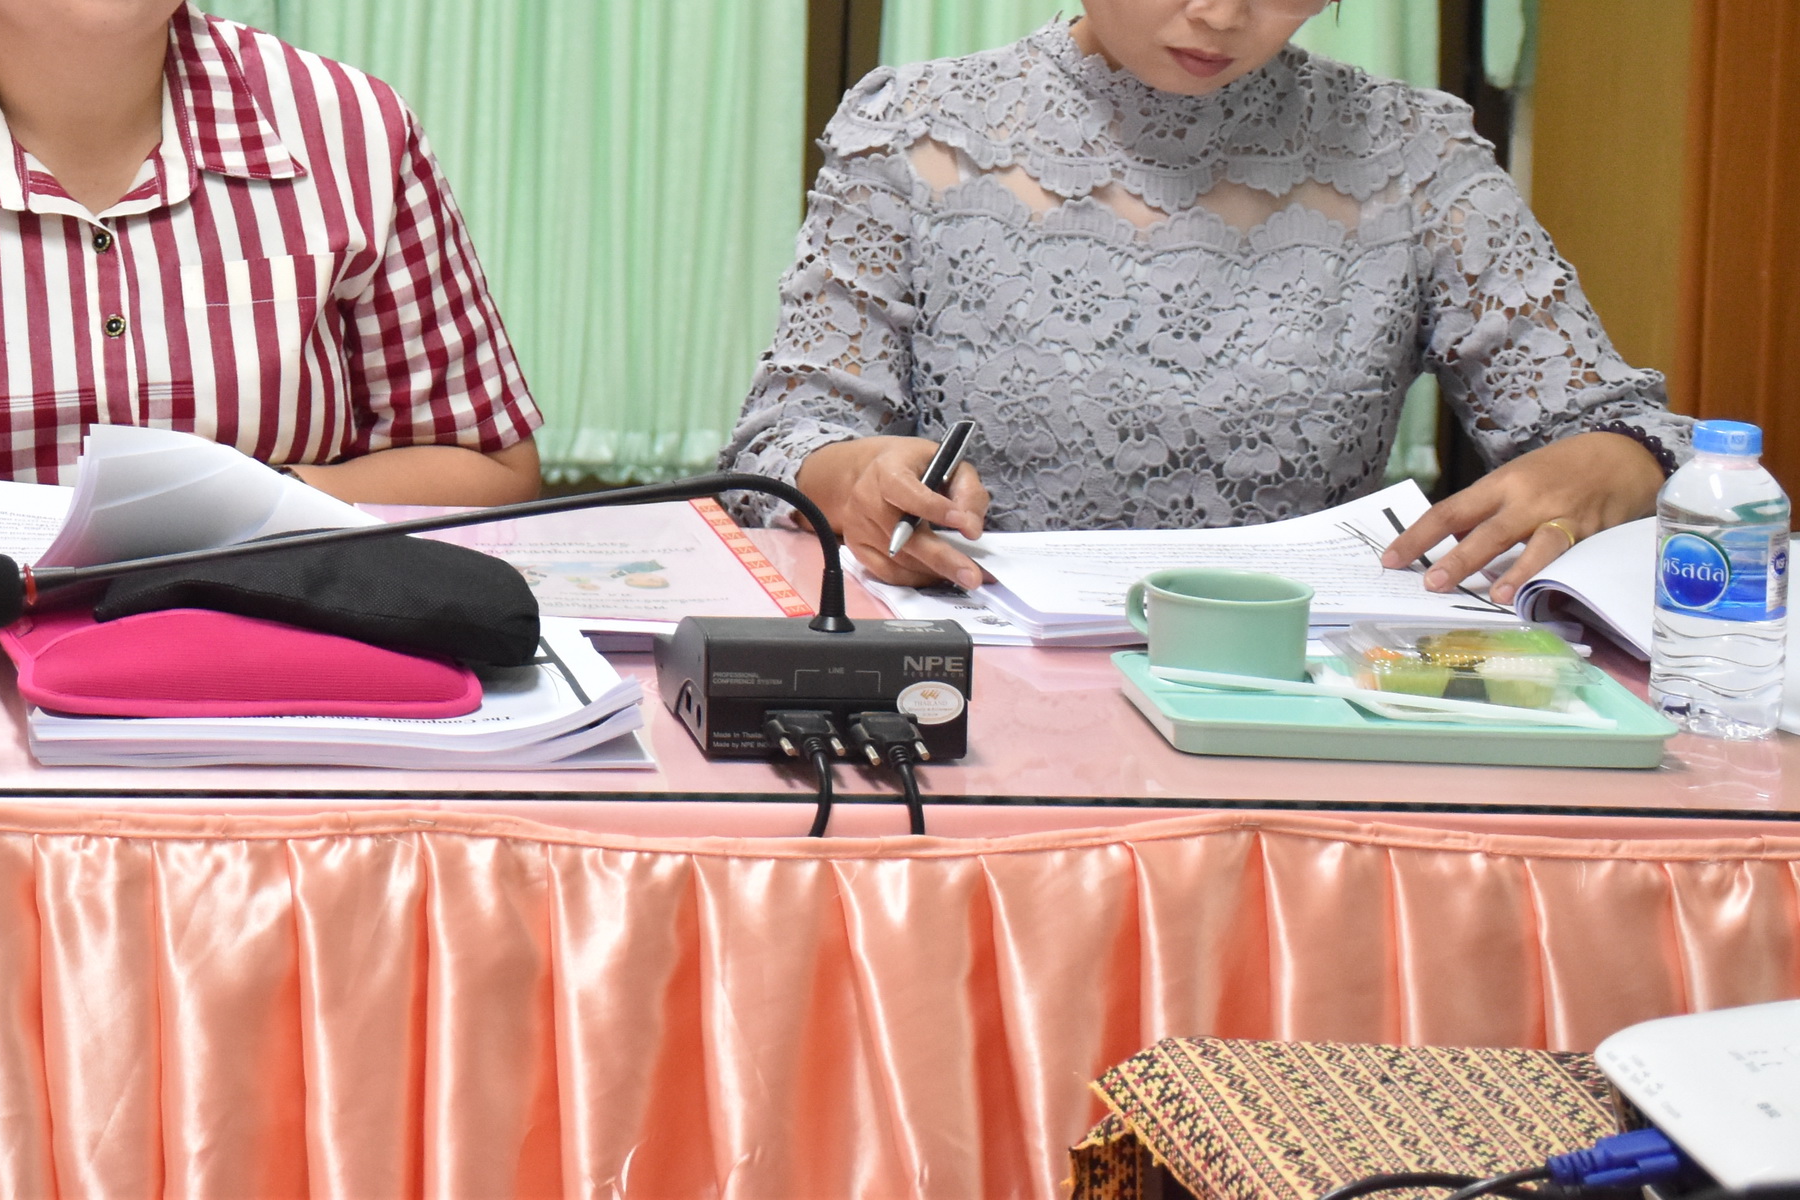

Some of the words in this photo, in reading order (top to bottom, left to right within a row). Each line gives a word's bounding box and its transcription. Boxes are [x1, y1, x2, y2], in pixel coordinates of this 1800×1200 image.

[1662, 557, 1725, 583] คริสตัล
[828, 666, 845, 675] LINE
[903, 655, 965, 673] NPE
[712, 677, 755, 685] CONFERENCE
[756, 678, 783, 686] SYSTEM
